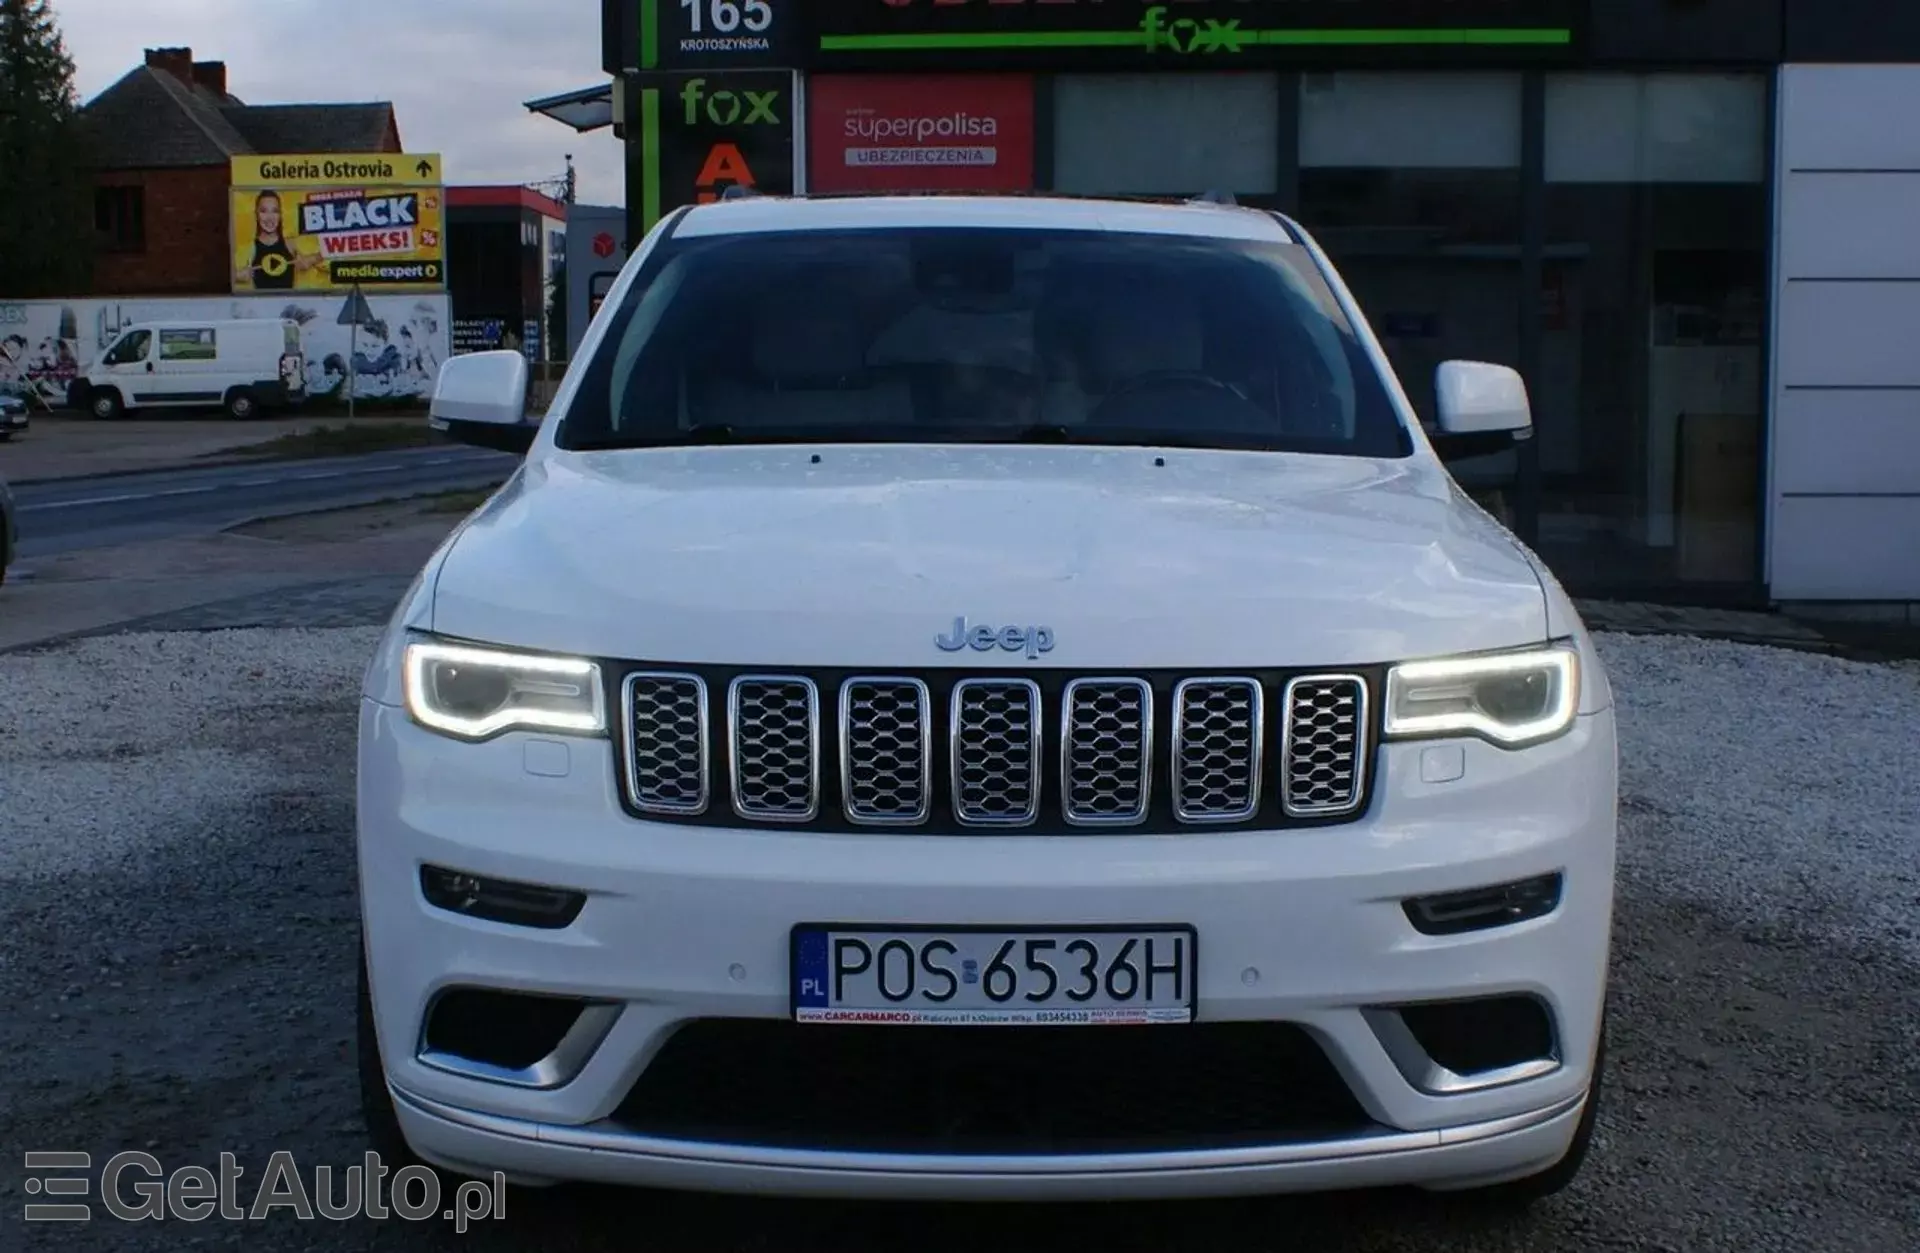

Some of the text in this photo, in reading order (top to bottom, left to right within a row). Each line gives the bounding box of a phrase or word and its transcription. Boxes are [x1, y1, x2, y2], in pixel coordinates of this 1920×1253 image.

[680, 0, 773, 33] 165
[1140, 6, 1242, 52] fox
[680, 37, 769, 51] KROTOSZYŃSKA
[680, 78, 780, 126] fox
[845, 112, 997, 142] superpolisa
[260, 159, 393, 180] Galeria Ostrovia
[857, 149, 984, 163] UBEZPIECZENIA
[303, 196, 414, 231] BLACK
[323, 230, 409, 254] WEEKS!
[336, 263, 424, 280] mediaexpert
[934, 615, 1055, 660] Jeep
[833, 938, 1184, 1002] POS 6536H
[801, 978, 824, 996] PL
